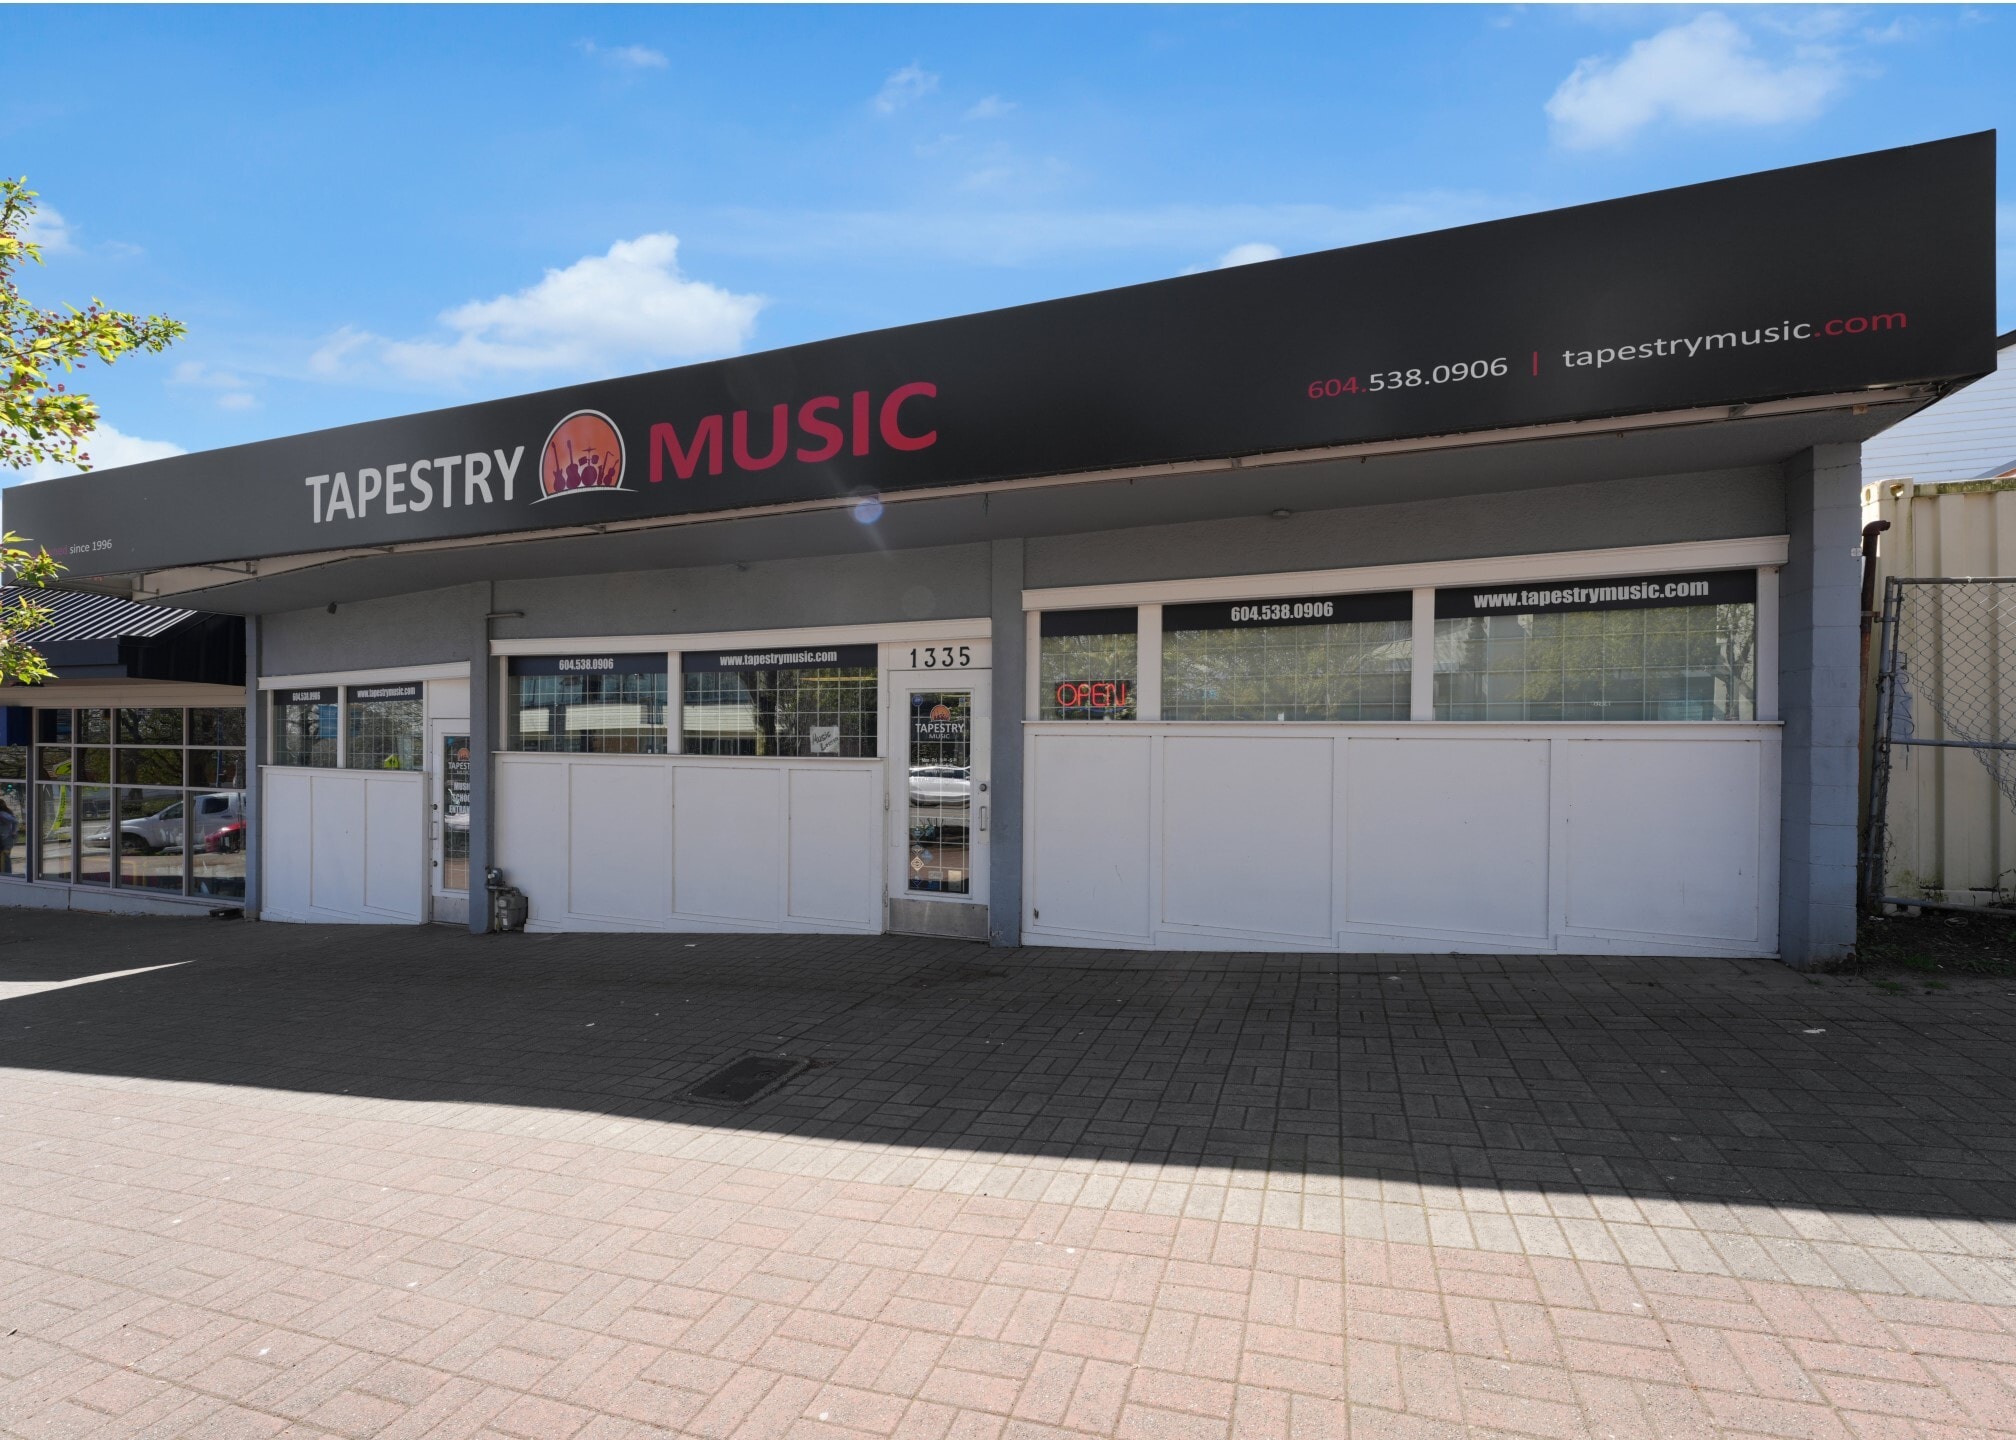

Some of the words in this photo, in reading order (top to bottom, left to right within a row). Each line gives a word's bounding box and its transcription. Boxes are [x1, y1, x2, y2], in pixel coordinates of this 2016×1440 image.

[1307, 357, 1509, 399] 604.538.0906
[1562, 312, 1907, 368] tapestrymusic.com
[305, 446, 525, 524] TAPESTRY
[649, 381, 938, 483] MUSIC
[69, 543, 90, 555] since
[92, 538, 113, 552] 1996
[1473, 581, 1709, 609] www.tapestrymusic.com
[1230, 601, 1334, 622] 604.538.0906
[558, 657, 614, 671] 604.538.0906
[719, 651, 838, 667] www.tapestrymusic.com
[910, 646, 971, 669] 1335
[357, 686, 416, 699] www.tapestrymusic.com
[1056, 682, 1127, 708] OPEN
[915, 723, 965, 733] TAPESTRY
